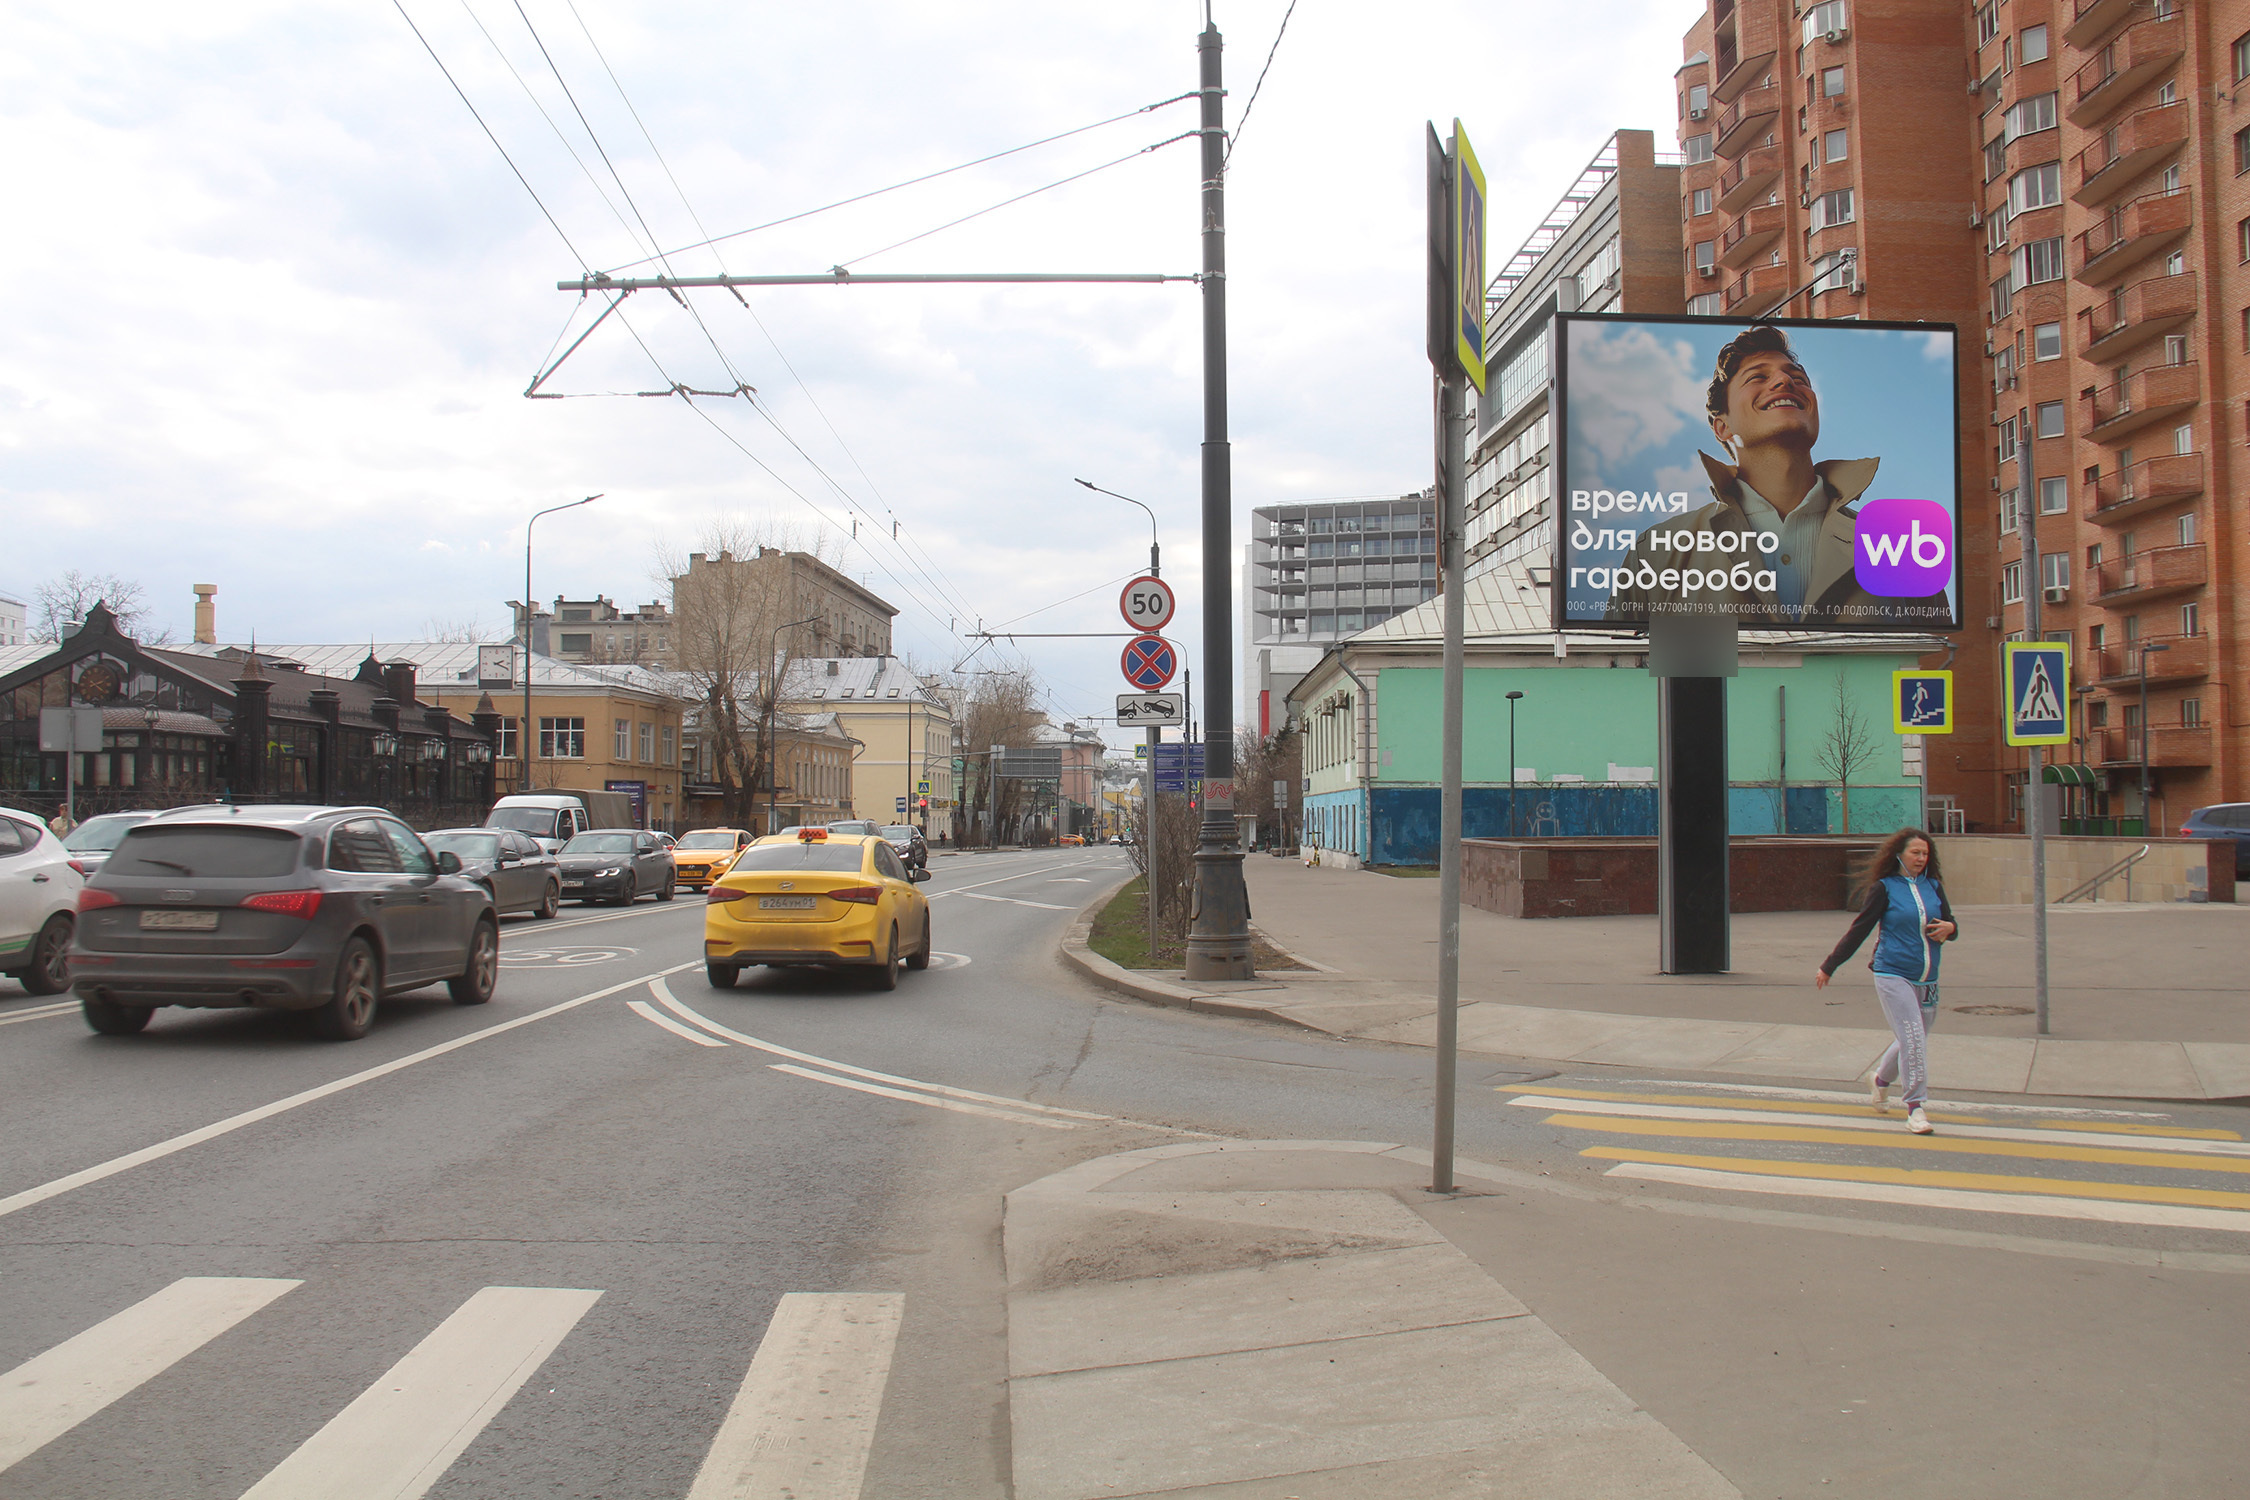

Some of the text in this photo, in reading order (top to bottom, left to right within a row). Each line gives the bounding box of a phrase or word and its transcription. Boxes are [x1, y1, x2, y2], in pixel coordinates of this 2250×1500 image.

[1571, 490, 1688, 519] время
[1571, 519, 1779, 554] для нового
[1861, 519, 1946, 568] wb
[1570, 560, 1777, 598] гардероба
[1133, 593, 1163, 615] 50
[1567, 601, 1586, 611] ООО
[1621, 601, 1644, 612] ОГРН
[1647, 602, 1716, 614] 1247700471919,
[1719, 603, 1777, 614] МОСКОВСКАЯ
